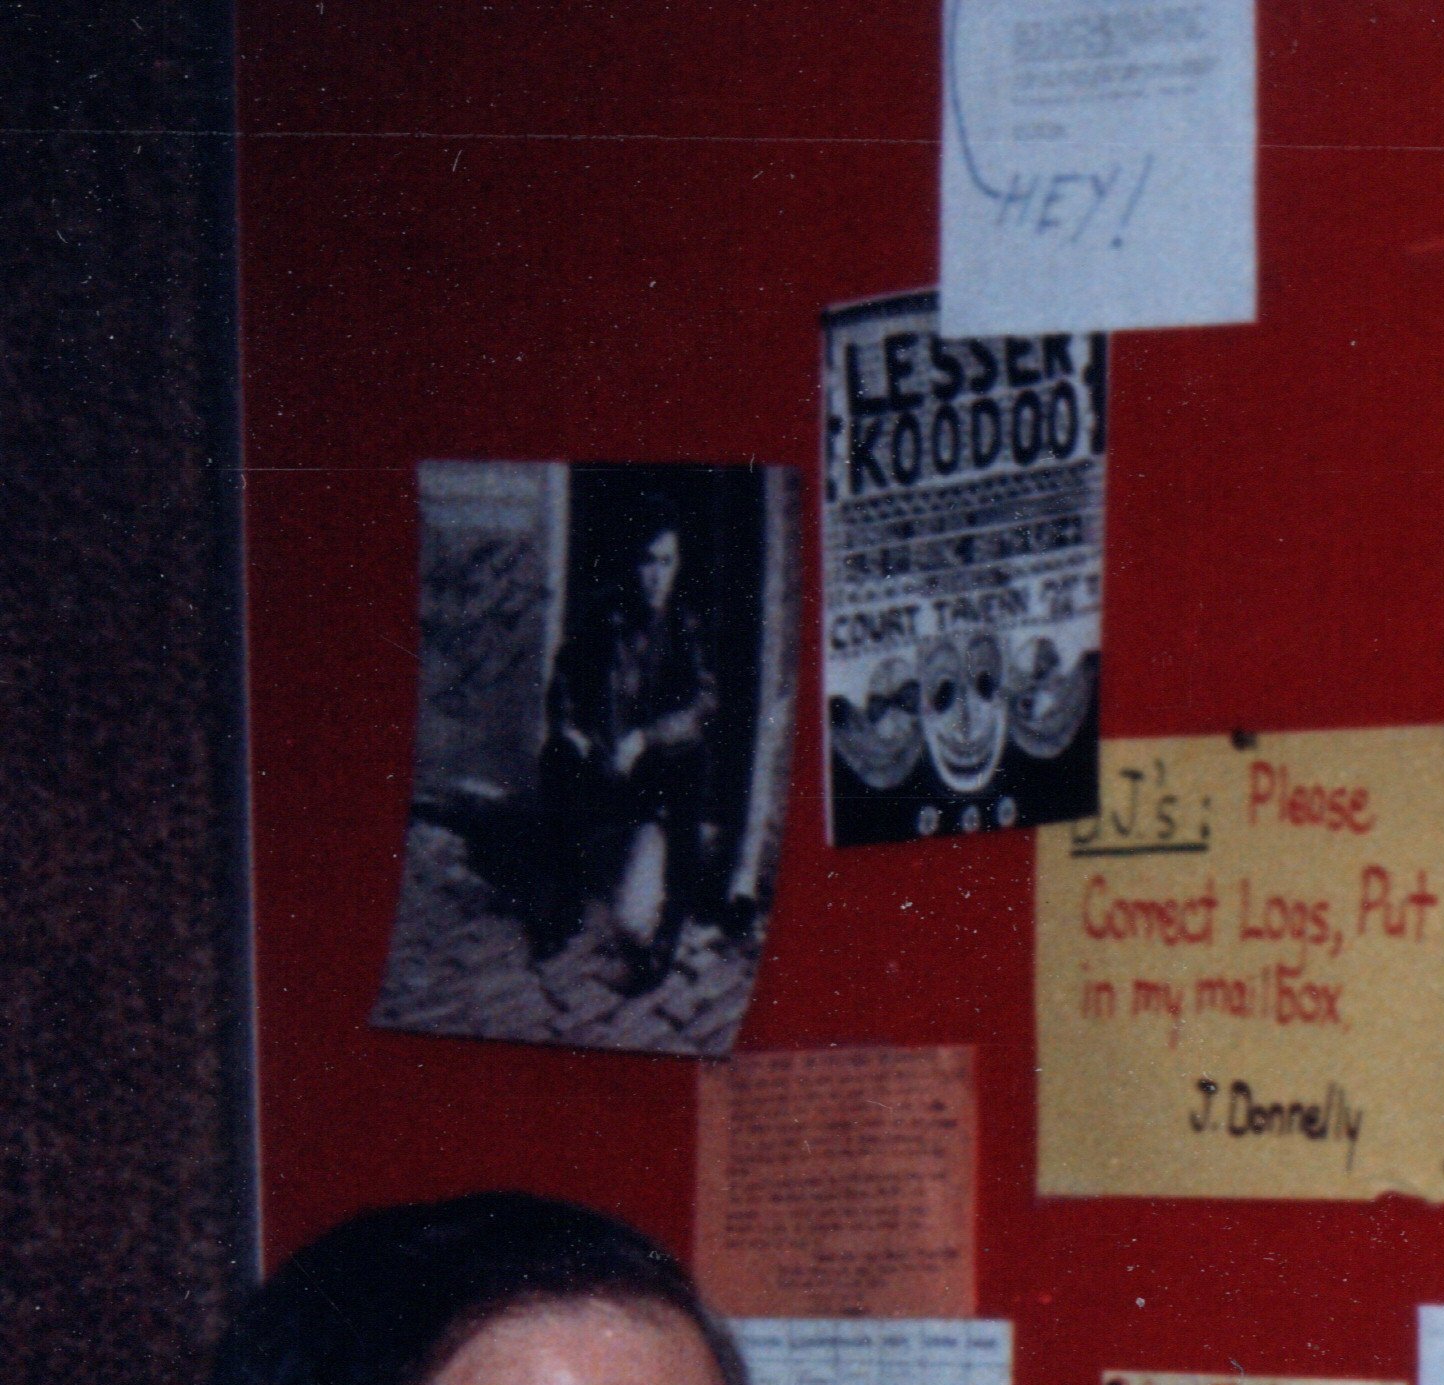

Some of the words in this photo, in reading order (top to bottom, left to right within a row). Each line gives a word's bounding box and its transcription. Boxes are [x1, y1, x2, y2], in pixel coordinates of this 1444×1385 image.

[998, 152, 1154, 250] HEY!
[846, 330, 1076, 416] LESSER
[1249, 760, 1378, 834] Please
[1081, 873, 1219, 947] Correct
[1358, 863, 1440, 945] Put
[1080, 961, 1117, 1020] in
[1131, 976, 1184, 1050] my
[1228, 1078, 1365, 1174] Donnelly
